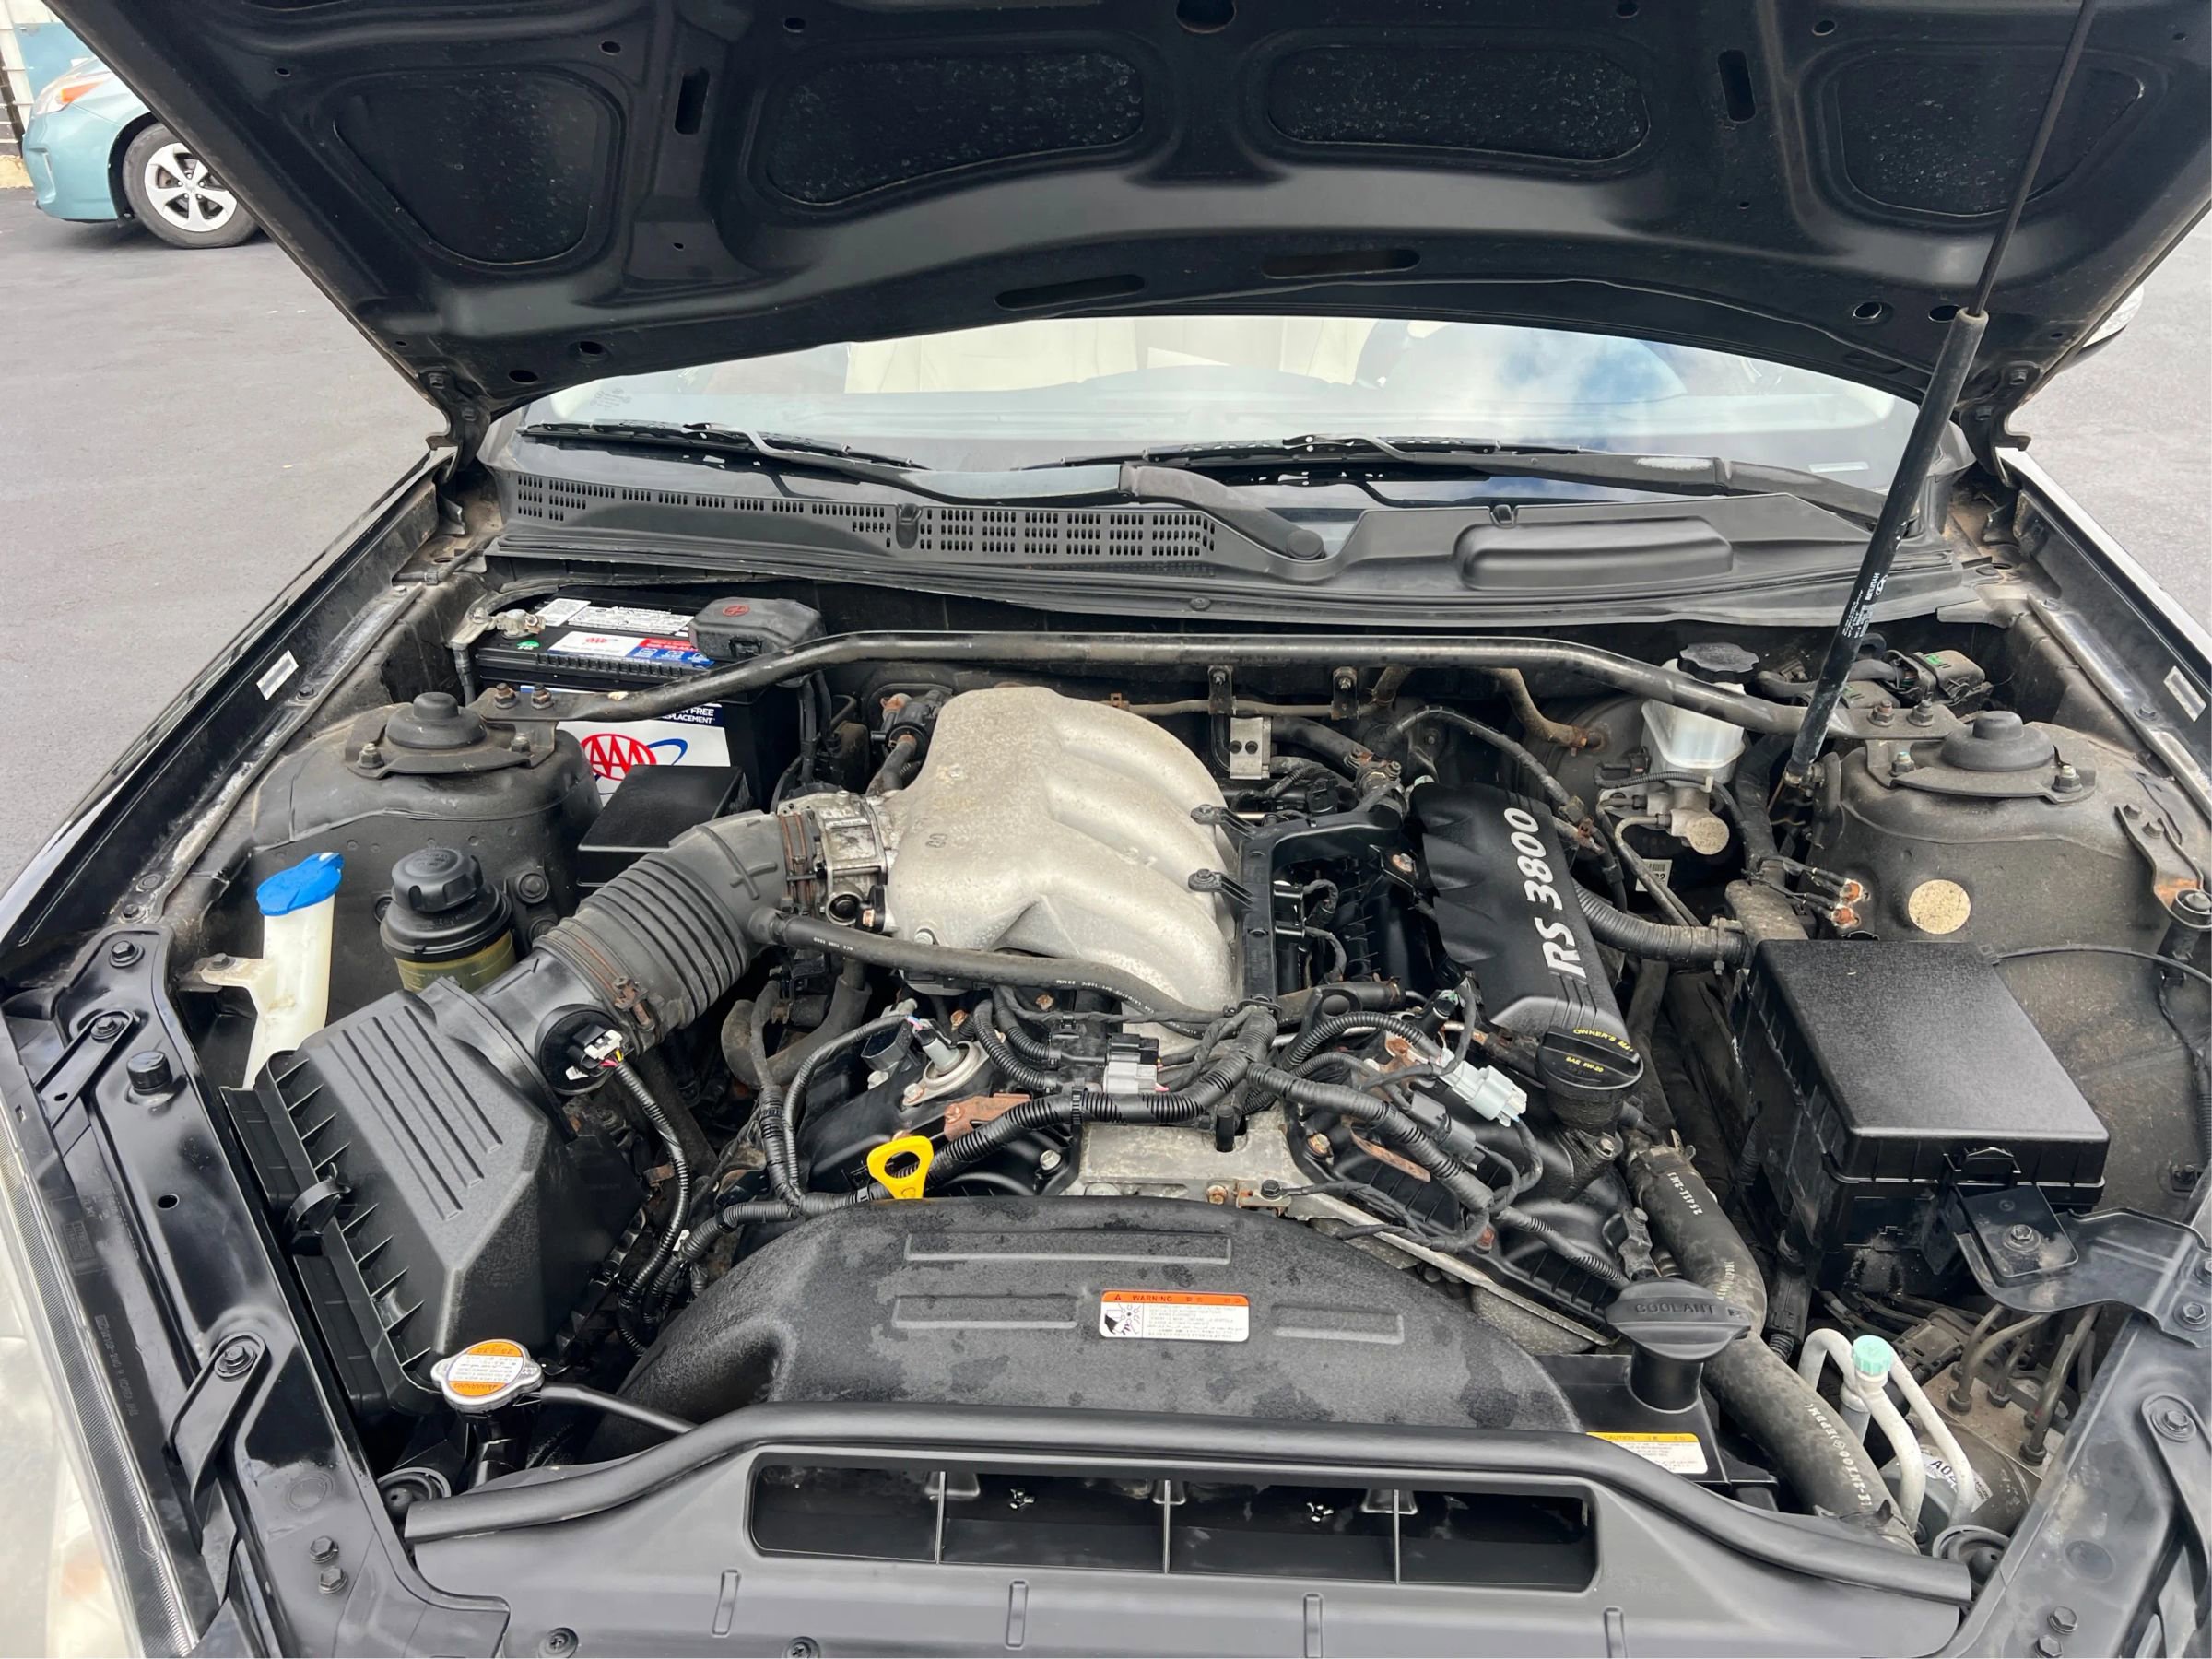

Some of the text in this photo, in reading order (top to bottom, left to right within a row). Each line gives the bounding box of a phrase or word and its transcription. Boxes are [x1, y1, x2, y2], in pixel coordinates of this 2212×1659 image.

[690, 708, 714, 717] FREE
[588, 735, 650, 780] AAA
[1503, 807, 1588, 980] RS 3800
[1572, 1029, 1617, 1042] OWNER'S
[1565, 1056, 1582, 1065] SAE
[1132, 1294, 1173, 1302] WARNING
[1634, 1302, 1715, 1315] COOLANT
